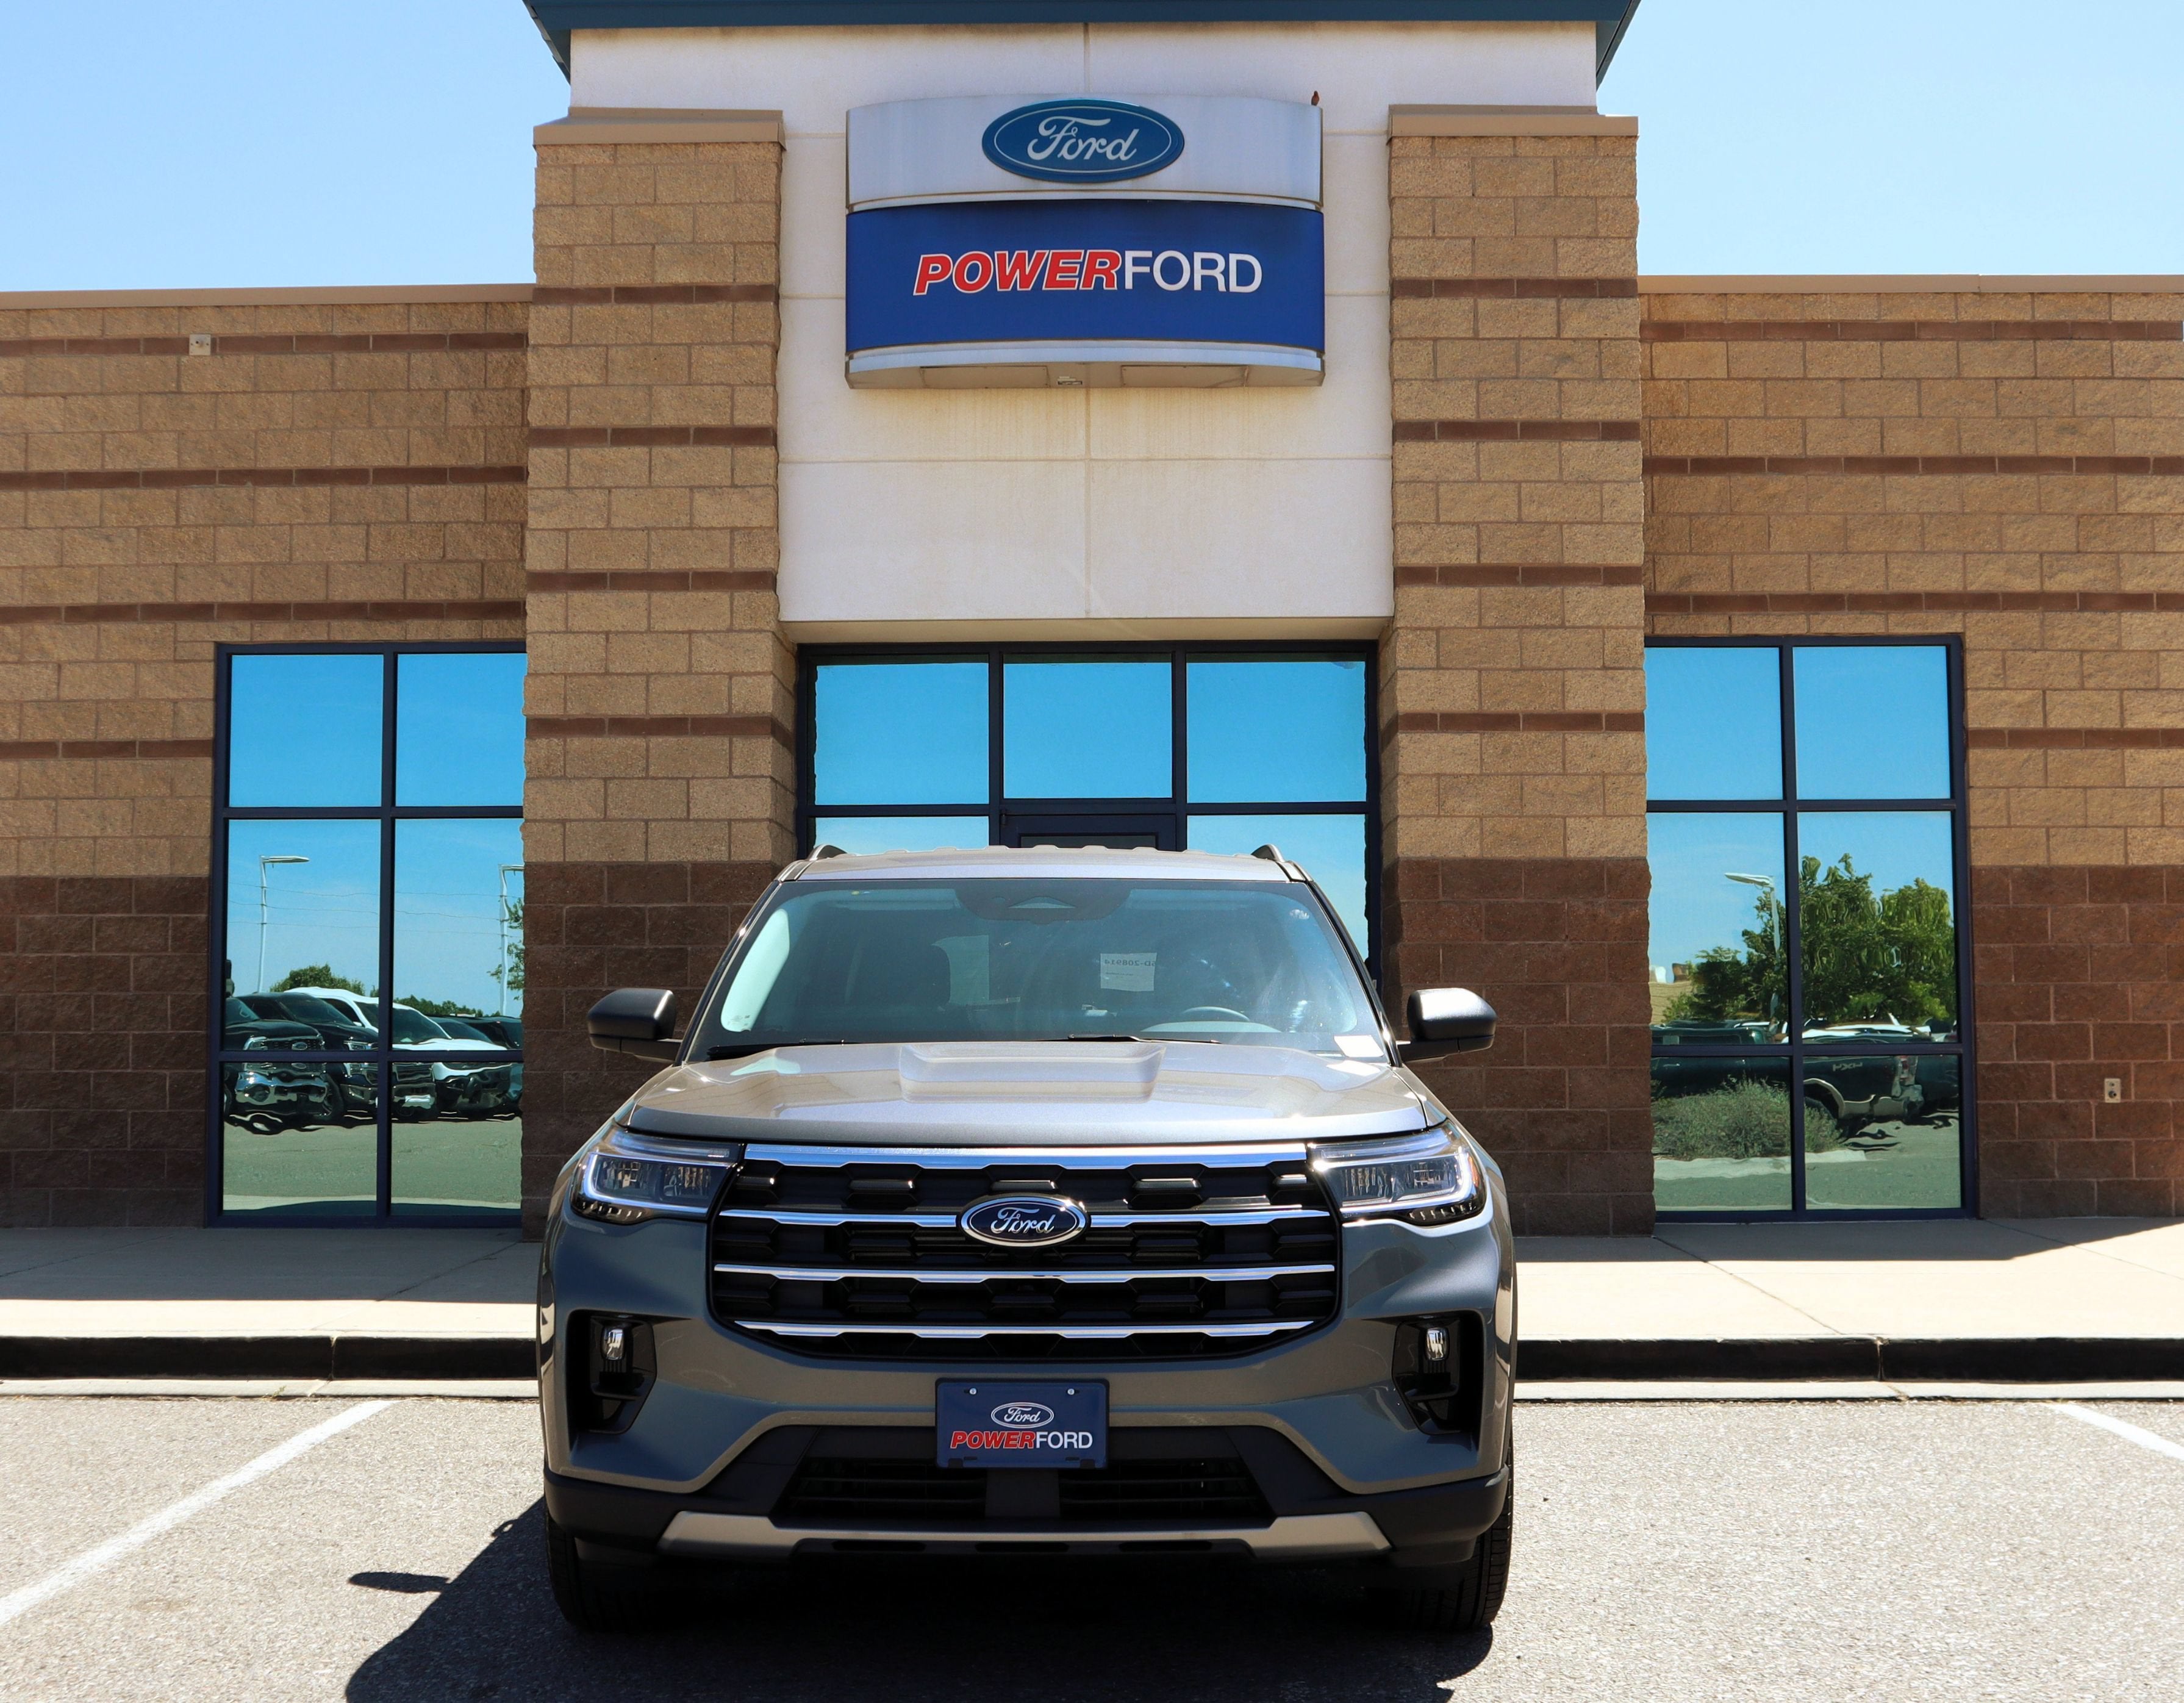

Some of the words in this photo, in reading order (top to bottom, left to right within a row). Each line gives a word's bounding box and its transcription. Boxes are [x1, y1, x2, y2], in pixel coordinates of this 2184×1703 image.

[1027, 116, 1139, 162] Ford
[912, 249, 1262, 296] POWERFORD
[990, 1207, 1056, 1233] Ford
[1003, 1407, 1040, 1423] Ford
[950, 1430, 1093, 1449] POWERFORD
